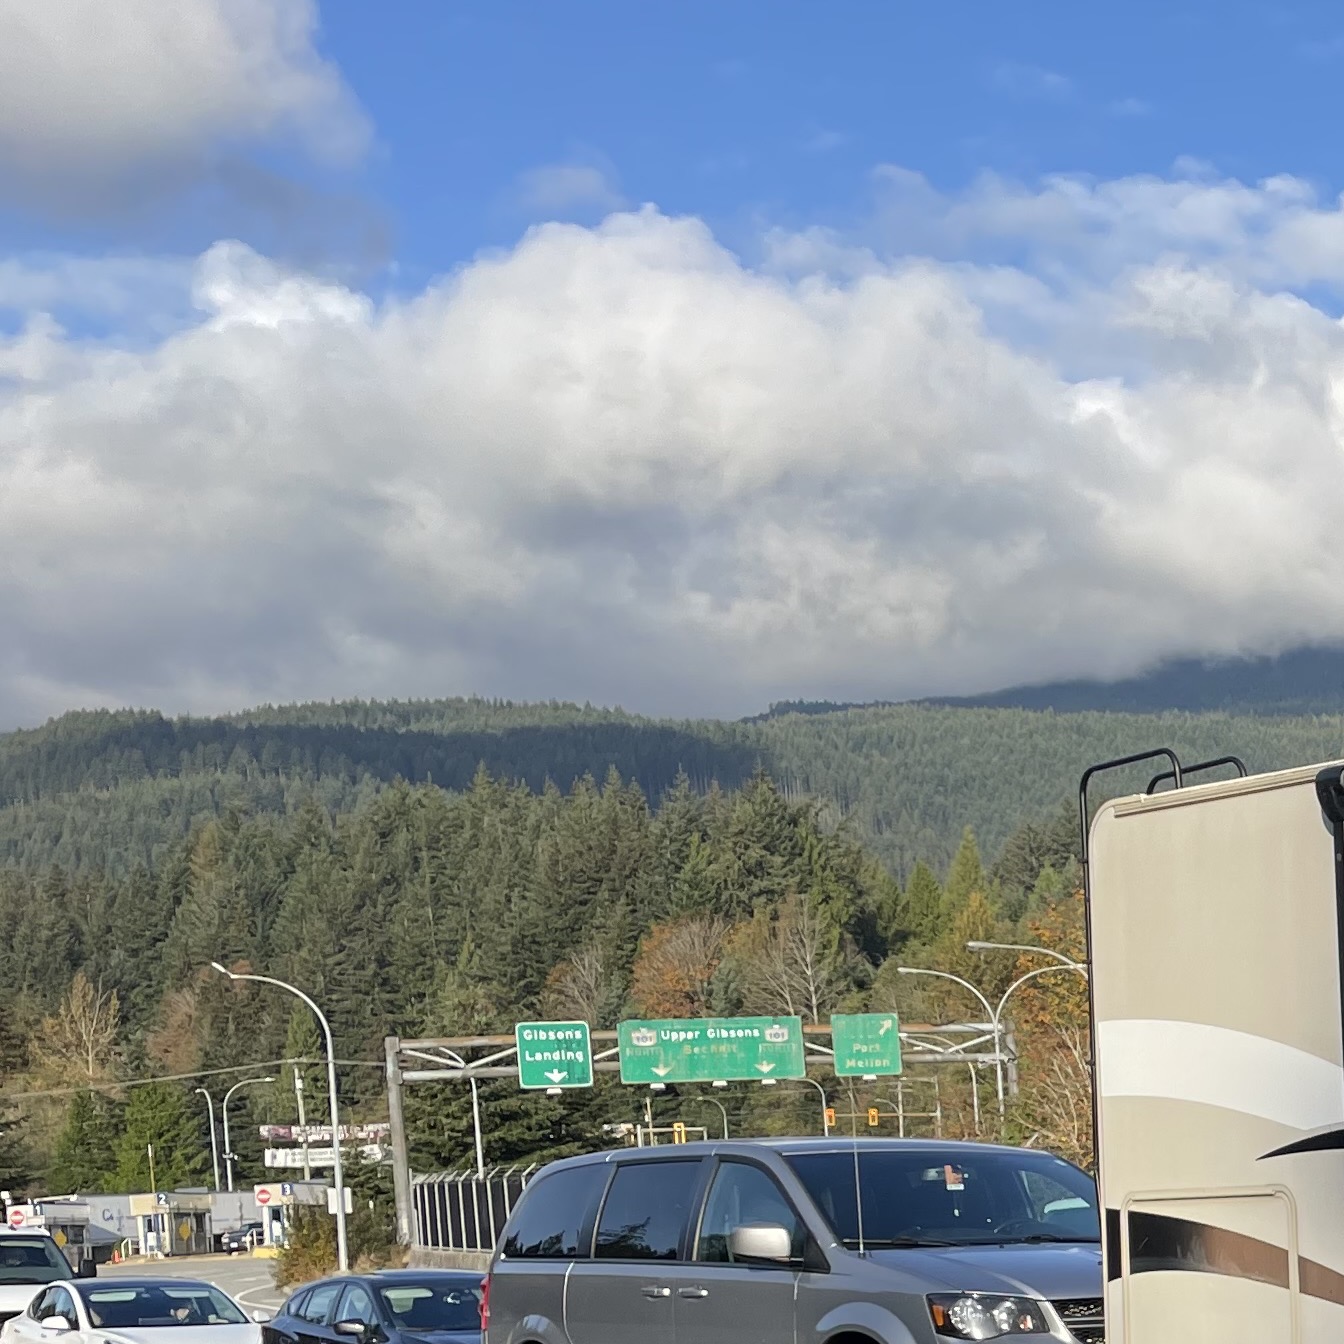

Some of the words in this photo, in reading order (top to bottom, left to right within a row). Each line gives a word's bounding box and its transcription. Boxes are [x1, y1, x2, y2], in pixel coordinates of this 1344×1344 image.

[523, 1029, 583, 1041] Gibsons
[661, 1030, 700, 1042] Upper
[706, 1028, 760, 1039] Gibsons
[853, 1043, 880, 1054] Port
[525, 1050, 584, 1063] Landing
[845, 1058, 891, 1069] Mellon
[284, 1184, 291, 1195] 3
[158, 1193, 167, 1205] 2
